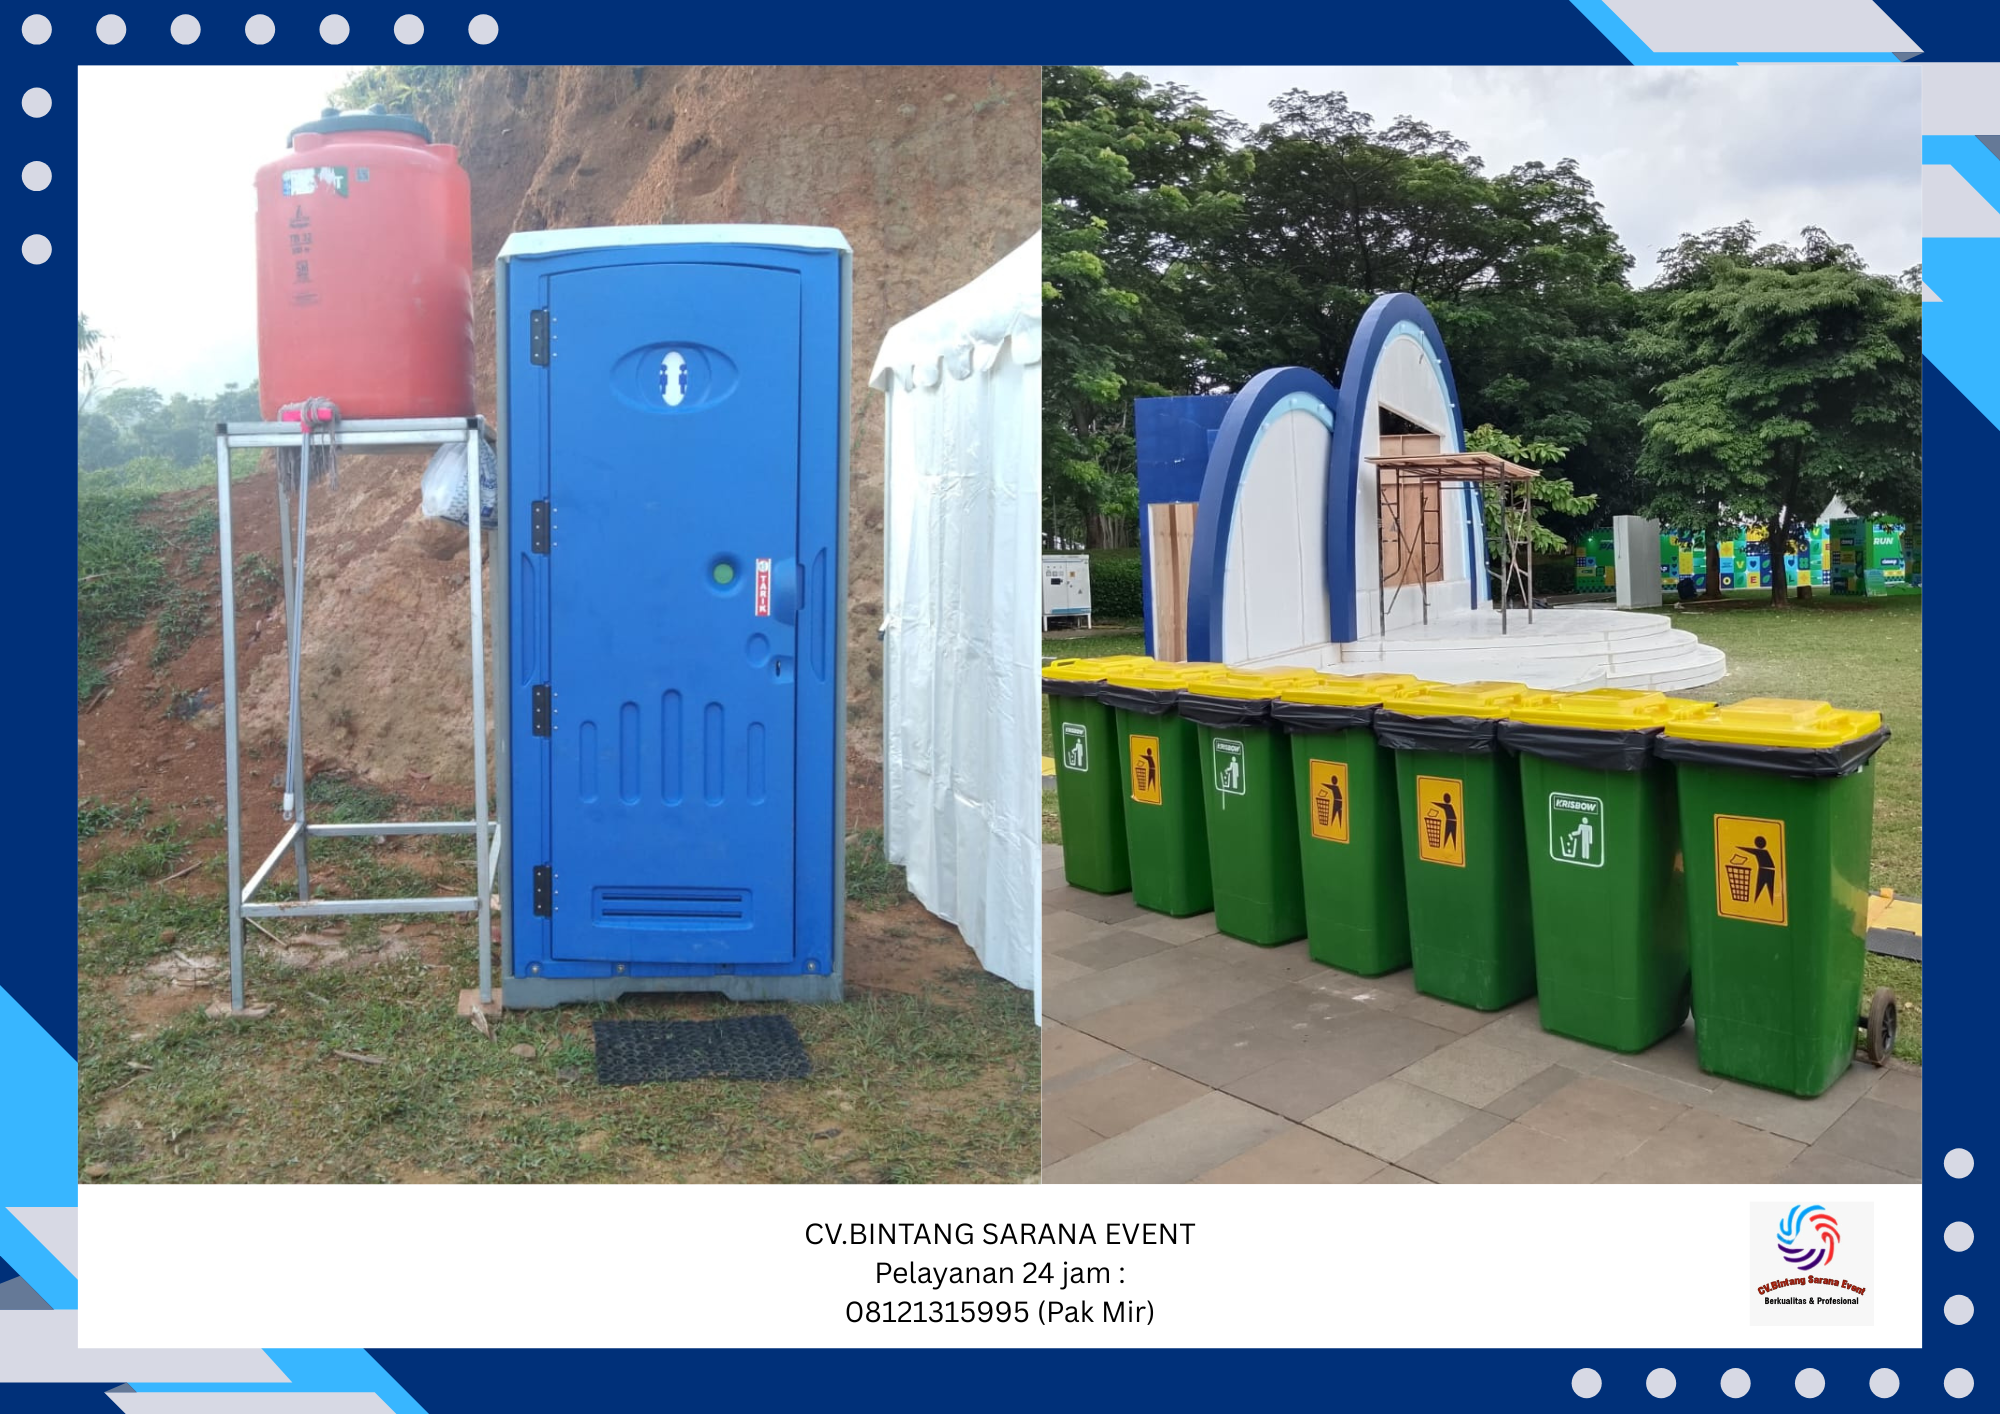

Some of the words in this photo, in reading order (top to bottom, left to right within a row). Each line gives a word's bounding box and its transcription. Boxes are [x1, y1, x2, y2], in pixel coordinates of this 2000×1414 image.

[1873, 537, 1894, 546] RUN
[758, 575, 768, 613] TARIK
[1555, 799, 1597, 812] KRISBOW
